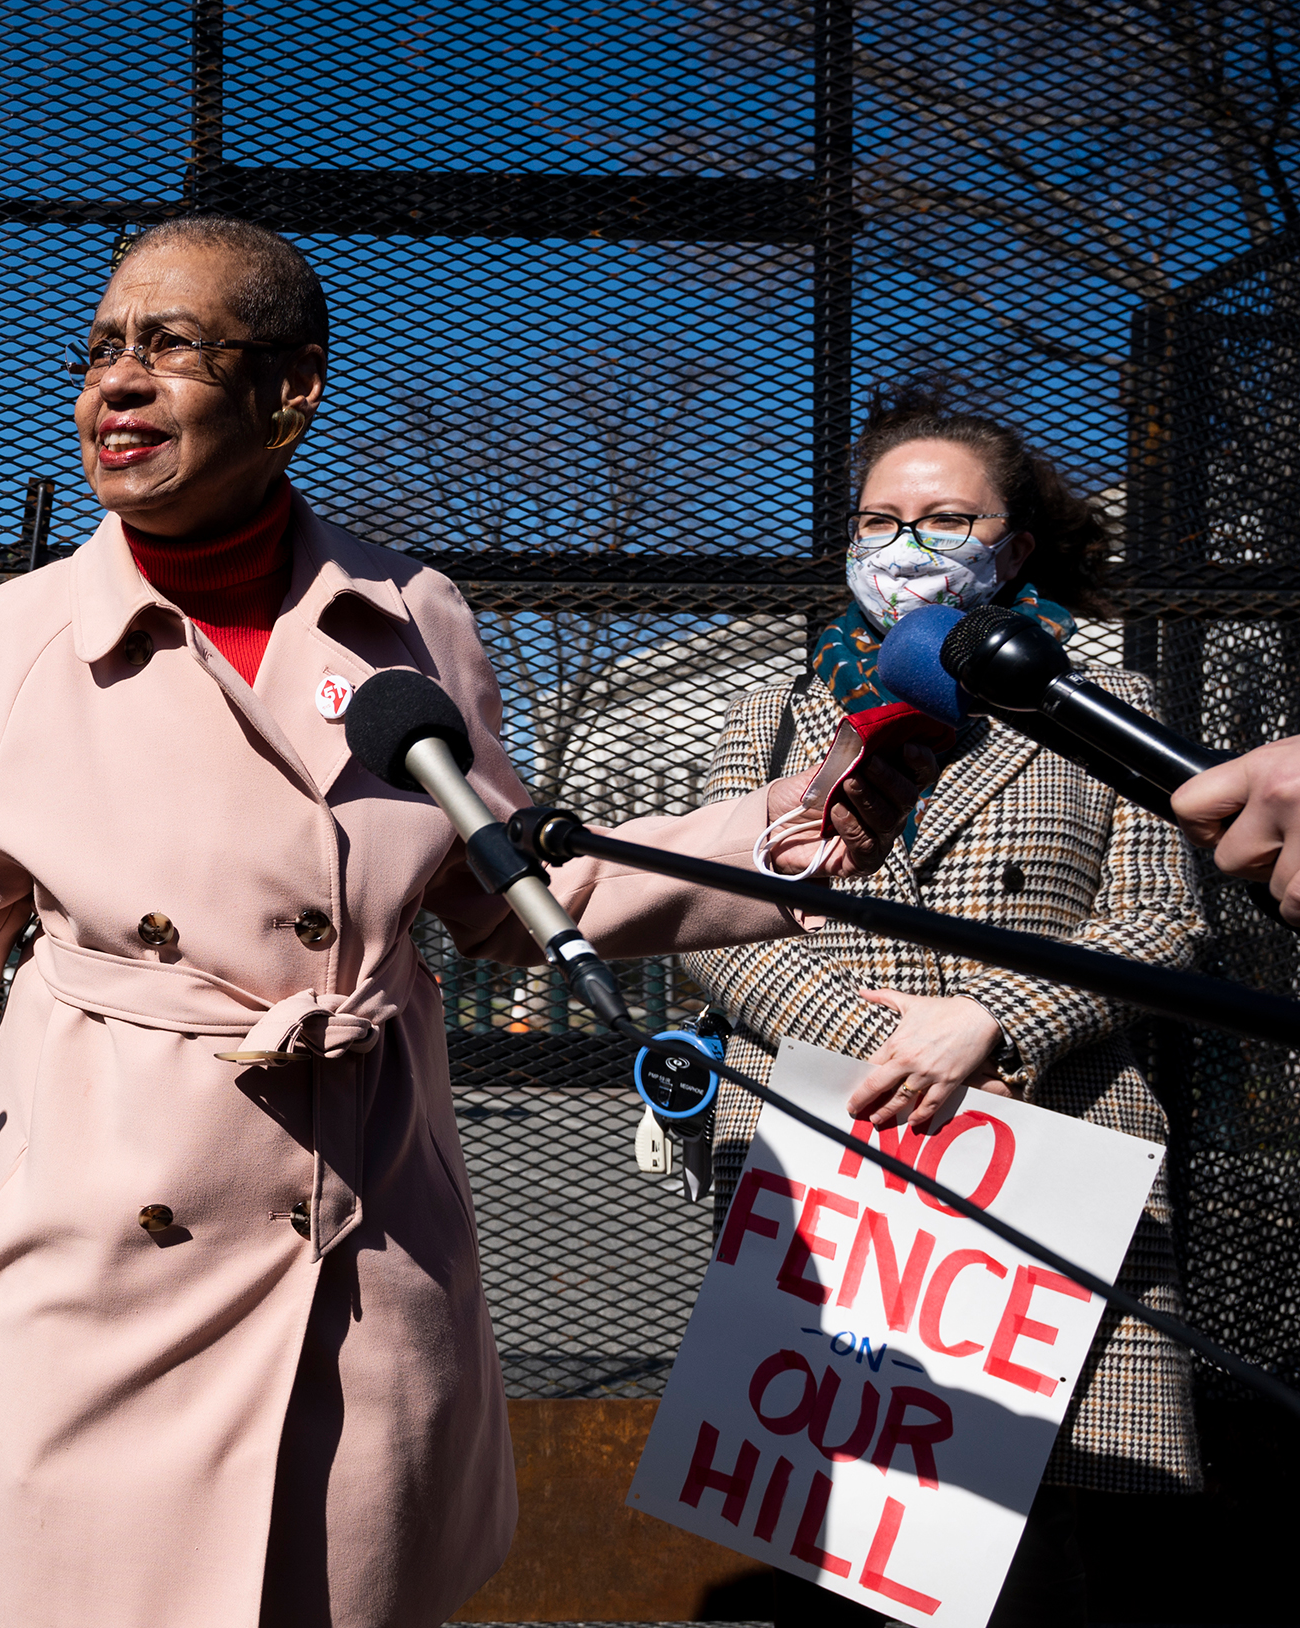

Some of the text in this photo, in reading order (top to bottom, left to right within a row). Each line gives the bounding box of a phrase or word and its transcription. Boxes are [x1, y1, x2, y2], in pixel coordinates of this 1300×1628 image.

[323, 683, 344, 704] 51
[679, 1082, 704, 1096] MEGAPHONE
[837, 1110, 1016, 1218] NO
[716, 1168, 1093, 1397] FENCE
[749, 1349, 953, 1490] OUR
[679, 1420, 942, 1616] HILL
